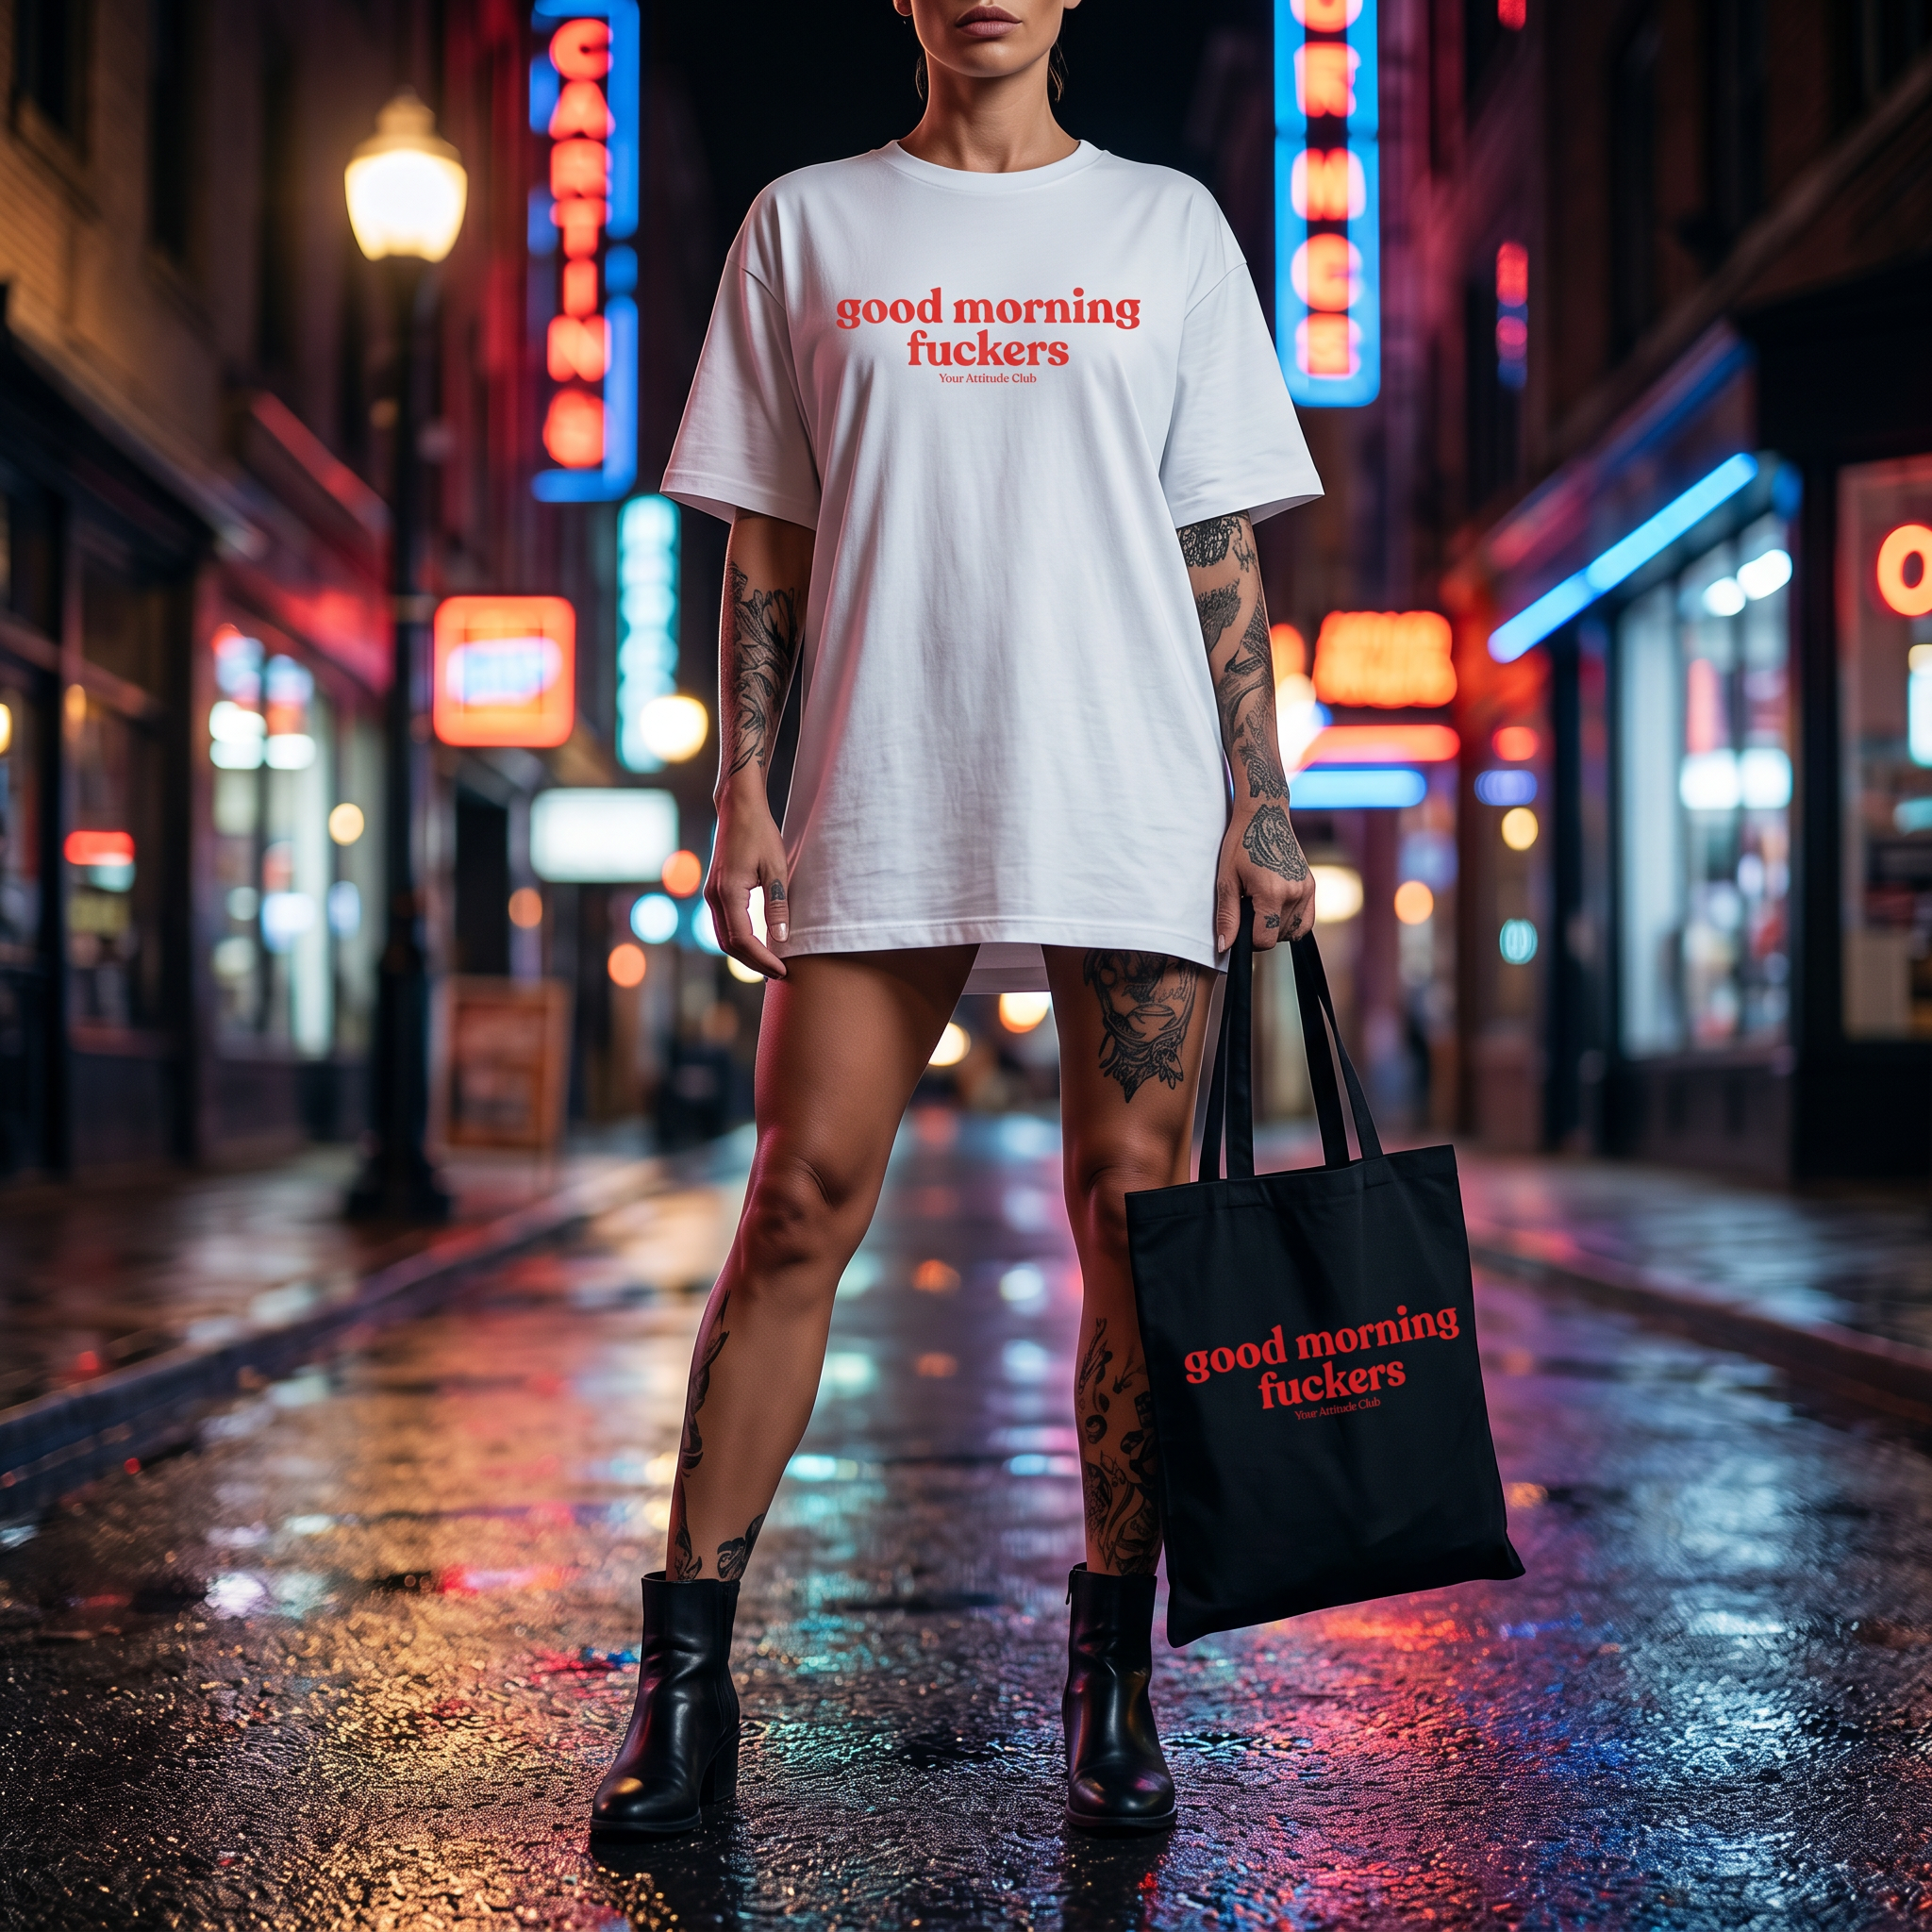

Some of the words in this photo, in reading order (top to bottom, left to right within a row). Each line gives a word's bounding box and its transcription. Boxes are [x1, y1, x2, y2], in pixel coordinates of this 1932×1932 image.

[836, 287, 943, 330] good
[953, 287, 1141, 330] morning
[907, 329, 1070, 367] fuckers
[939, 373, 964, 383] Your
[966, 373, 1010, 383] Attitude
[1011, 373, 1037, 384] Club
[1184, 1324, 1288, 1384] good
[1296, 1305, 1460, 1360] morning
[1257, 1360, 1407, 1409] fuckers
[1293, 1409, 1318, 1421] Your
[1319, 1401, 1357, 1417] Attitude
[1357, 1396, 1381, 1409] Club
